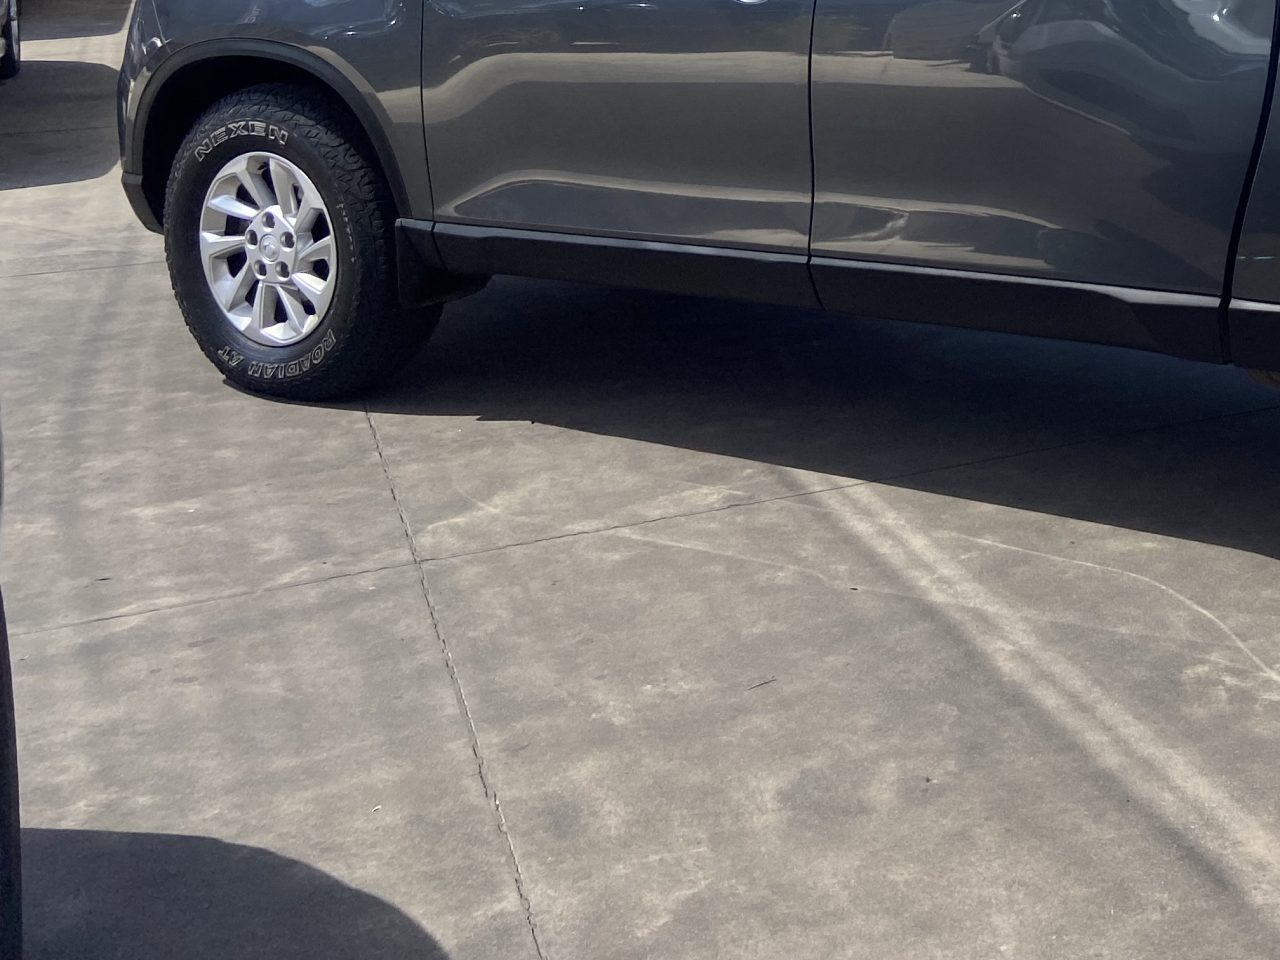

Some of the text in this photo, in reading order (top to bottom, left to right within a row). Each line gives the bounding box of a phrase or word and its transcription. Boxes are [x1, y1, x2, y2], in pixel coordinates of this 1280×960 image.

[194, 121, 289, 162] NEXEN
[217, 329, 336, 379] ROADIAN AT
